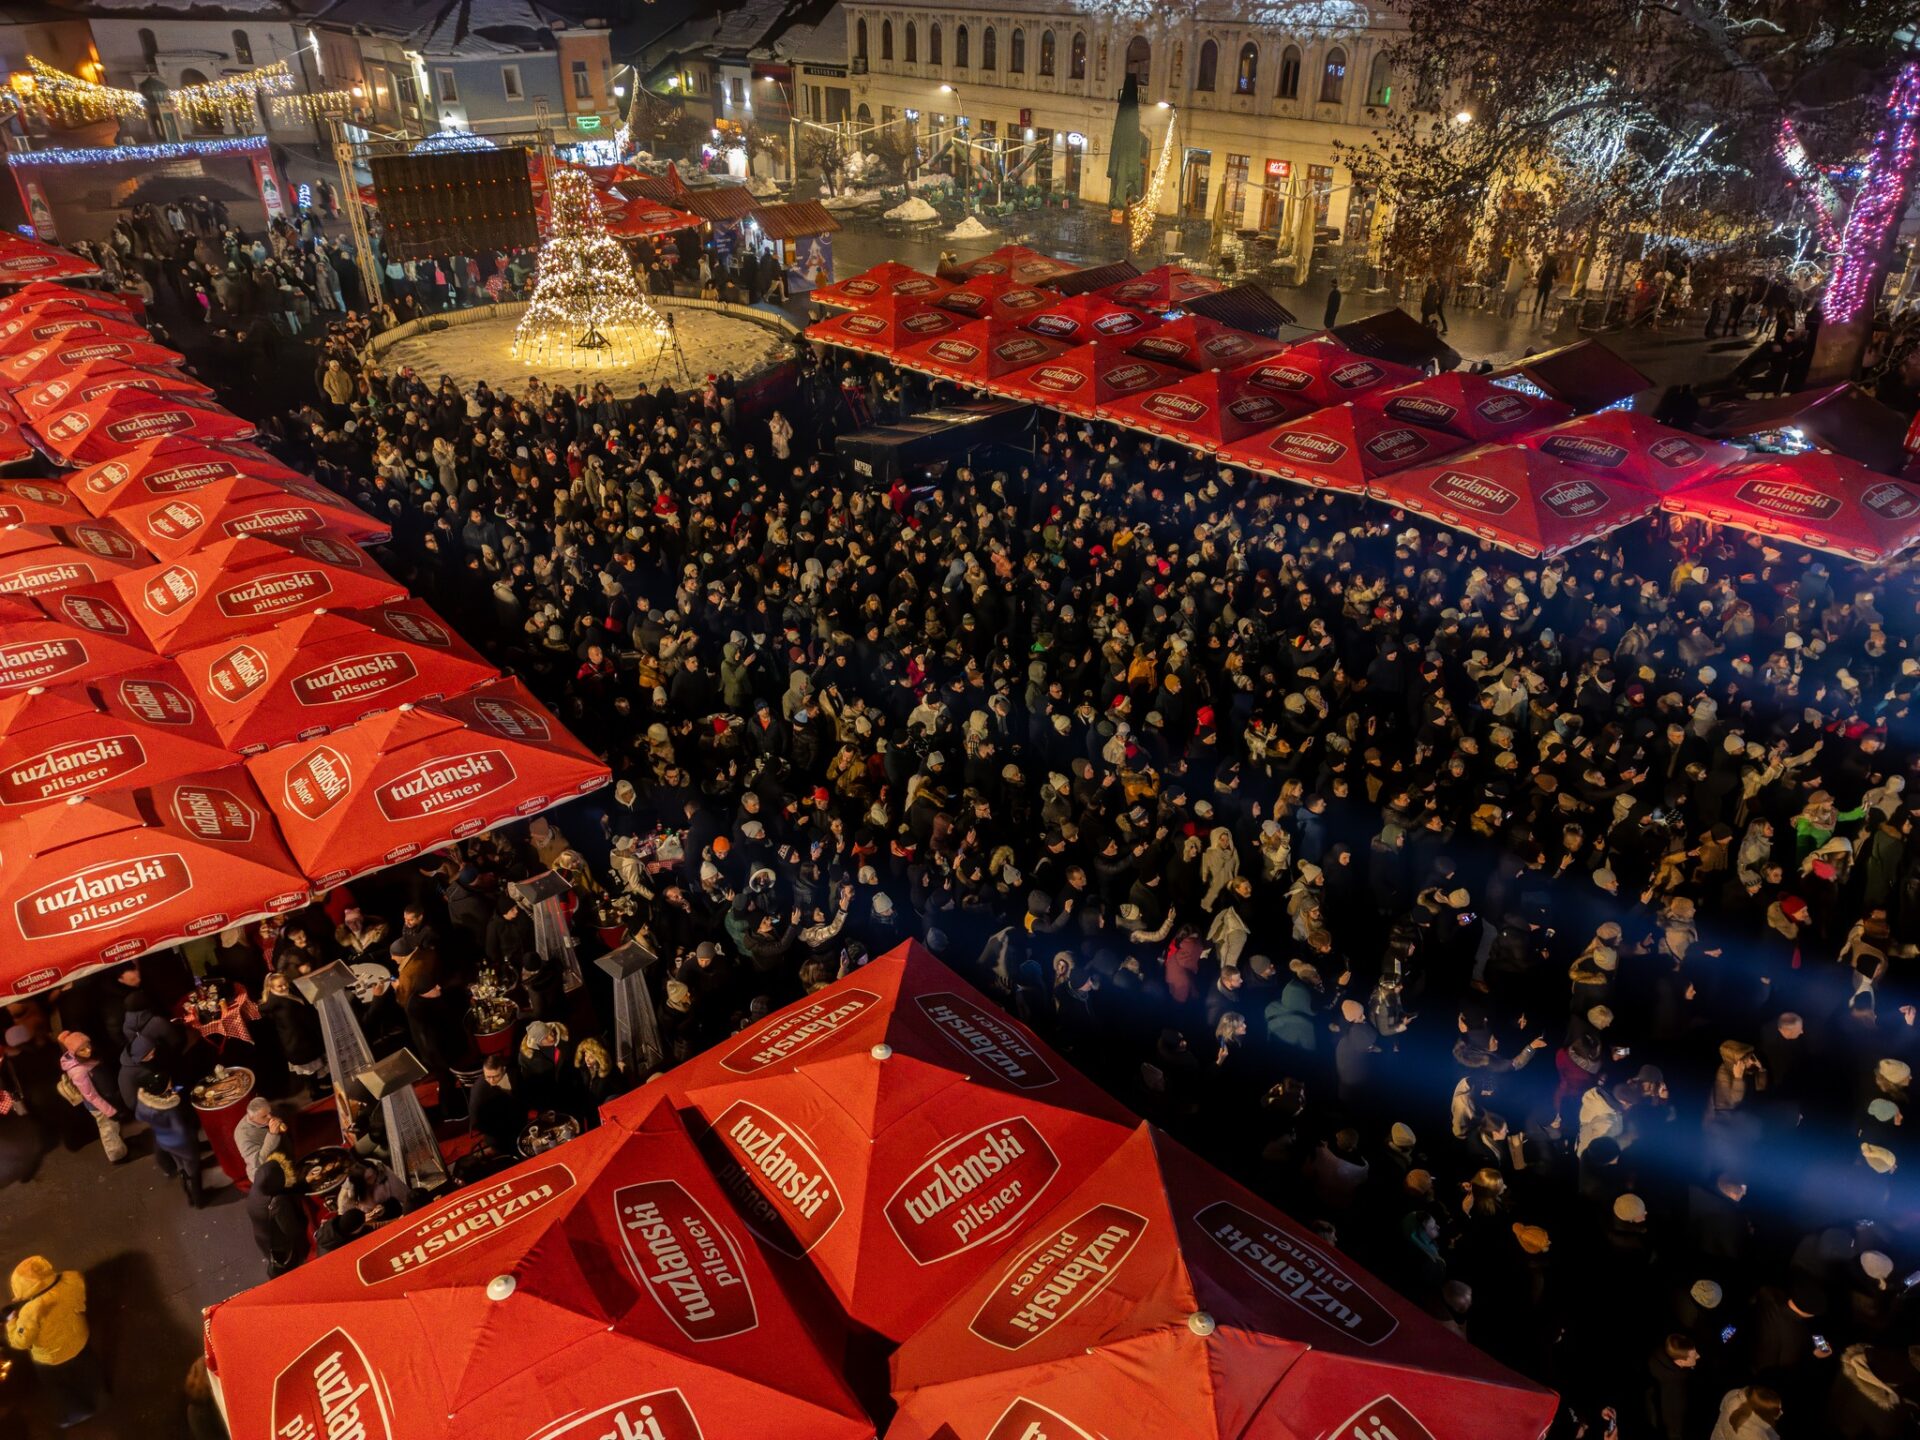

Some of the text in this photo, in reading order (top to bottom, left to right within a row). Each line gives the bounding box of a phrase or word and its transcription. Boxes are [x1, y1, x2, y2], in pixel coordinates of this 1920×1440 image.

[116, 413, 181, 433] tuzlanski
[1284, 434, 1340, 455] tuzlanski
[154, 464, 224, 485] tuzlanski
[1446, 475, 1510, 504] tuzlanski
[1446, 490, 1485, 508] pilsner
[1752, 483, 1830, 509] tuzlanski
[1757, 498, 1805, 513] pilsner
[235, 509, 308, 532] tuzlanski
[0, 566, 79, 592] uzlanski
[229, 573, 314, 604] tuzlanski
[253, 592, 304, 613] pilsner
[0, 642, 68, 669] lanski
[305, 655, 398, 690] tuzlanski
[332, 677, 387, 700] pilsner
[11, 740, 124, 785] tuzlanski
[40, 766, 108, 797] pilsner
[308, 753, 348, 801] tuzlanski
[391, 755, 493, 802] tuzlanski
[421, 782, 481, 812] pilsner
[35, 860, 166, 915] tuzlanski
[69, 893, 148, 929] pilsner
[752, 998, 864, 1065] tuzlanski
[760, 1005, 824, 1044] pilsner
[931, 1004, 1028, 1080] tuzlanski
[970, 1012, 1033, 1058] pilsner
[729, 1115, 831, 1219] tuzlanski
[904, 1127, 1027, 1226] tuzlanski
[391, 1184, 554, 1273] tuzlanski
[416, 1182, 514, 1239] pilsner
[952, 1177, 1022, 1244] pilsner
[625, 1200, 716, 1322] tuzlanski
[681, 1216, 741, 1288] pilsner
[1011, 1232, 1078, 1298] pilsner
[1264, 1232, 1352, 1293] pilsner
[1009, 1224, 1130, 1335] tuzlanski
[1214, 1224, 1362, 1329] tuzlanski
